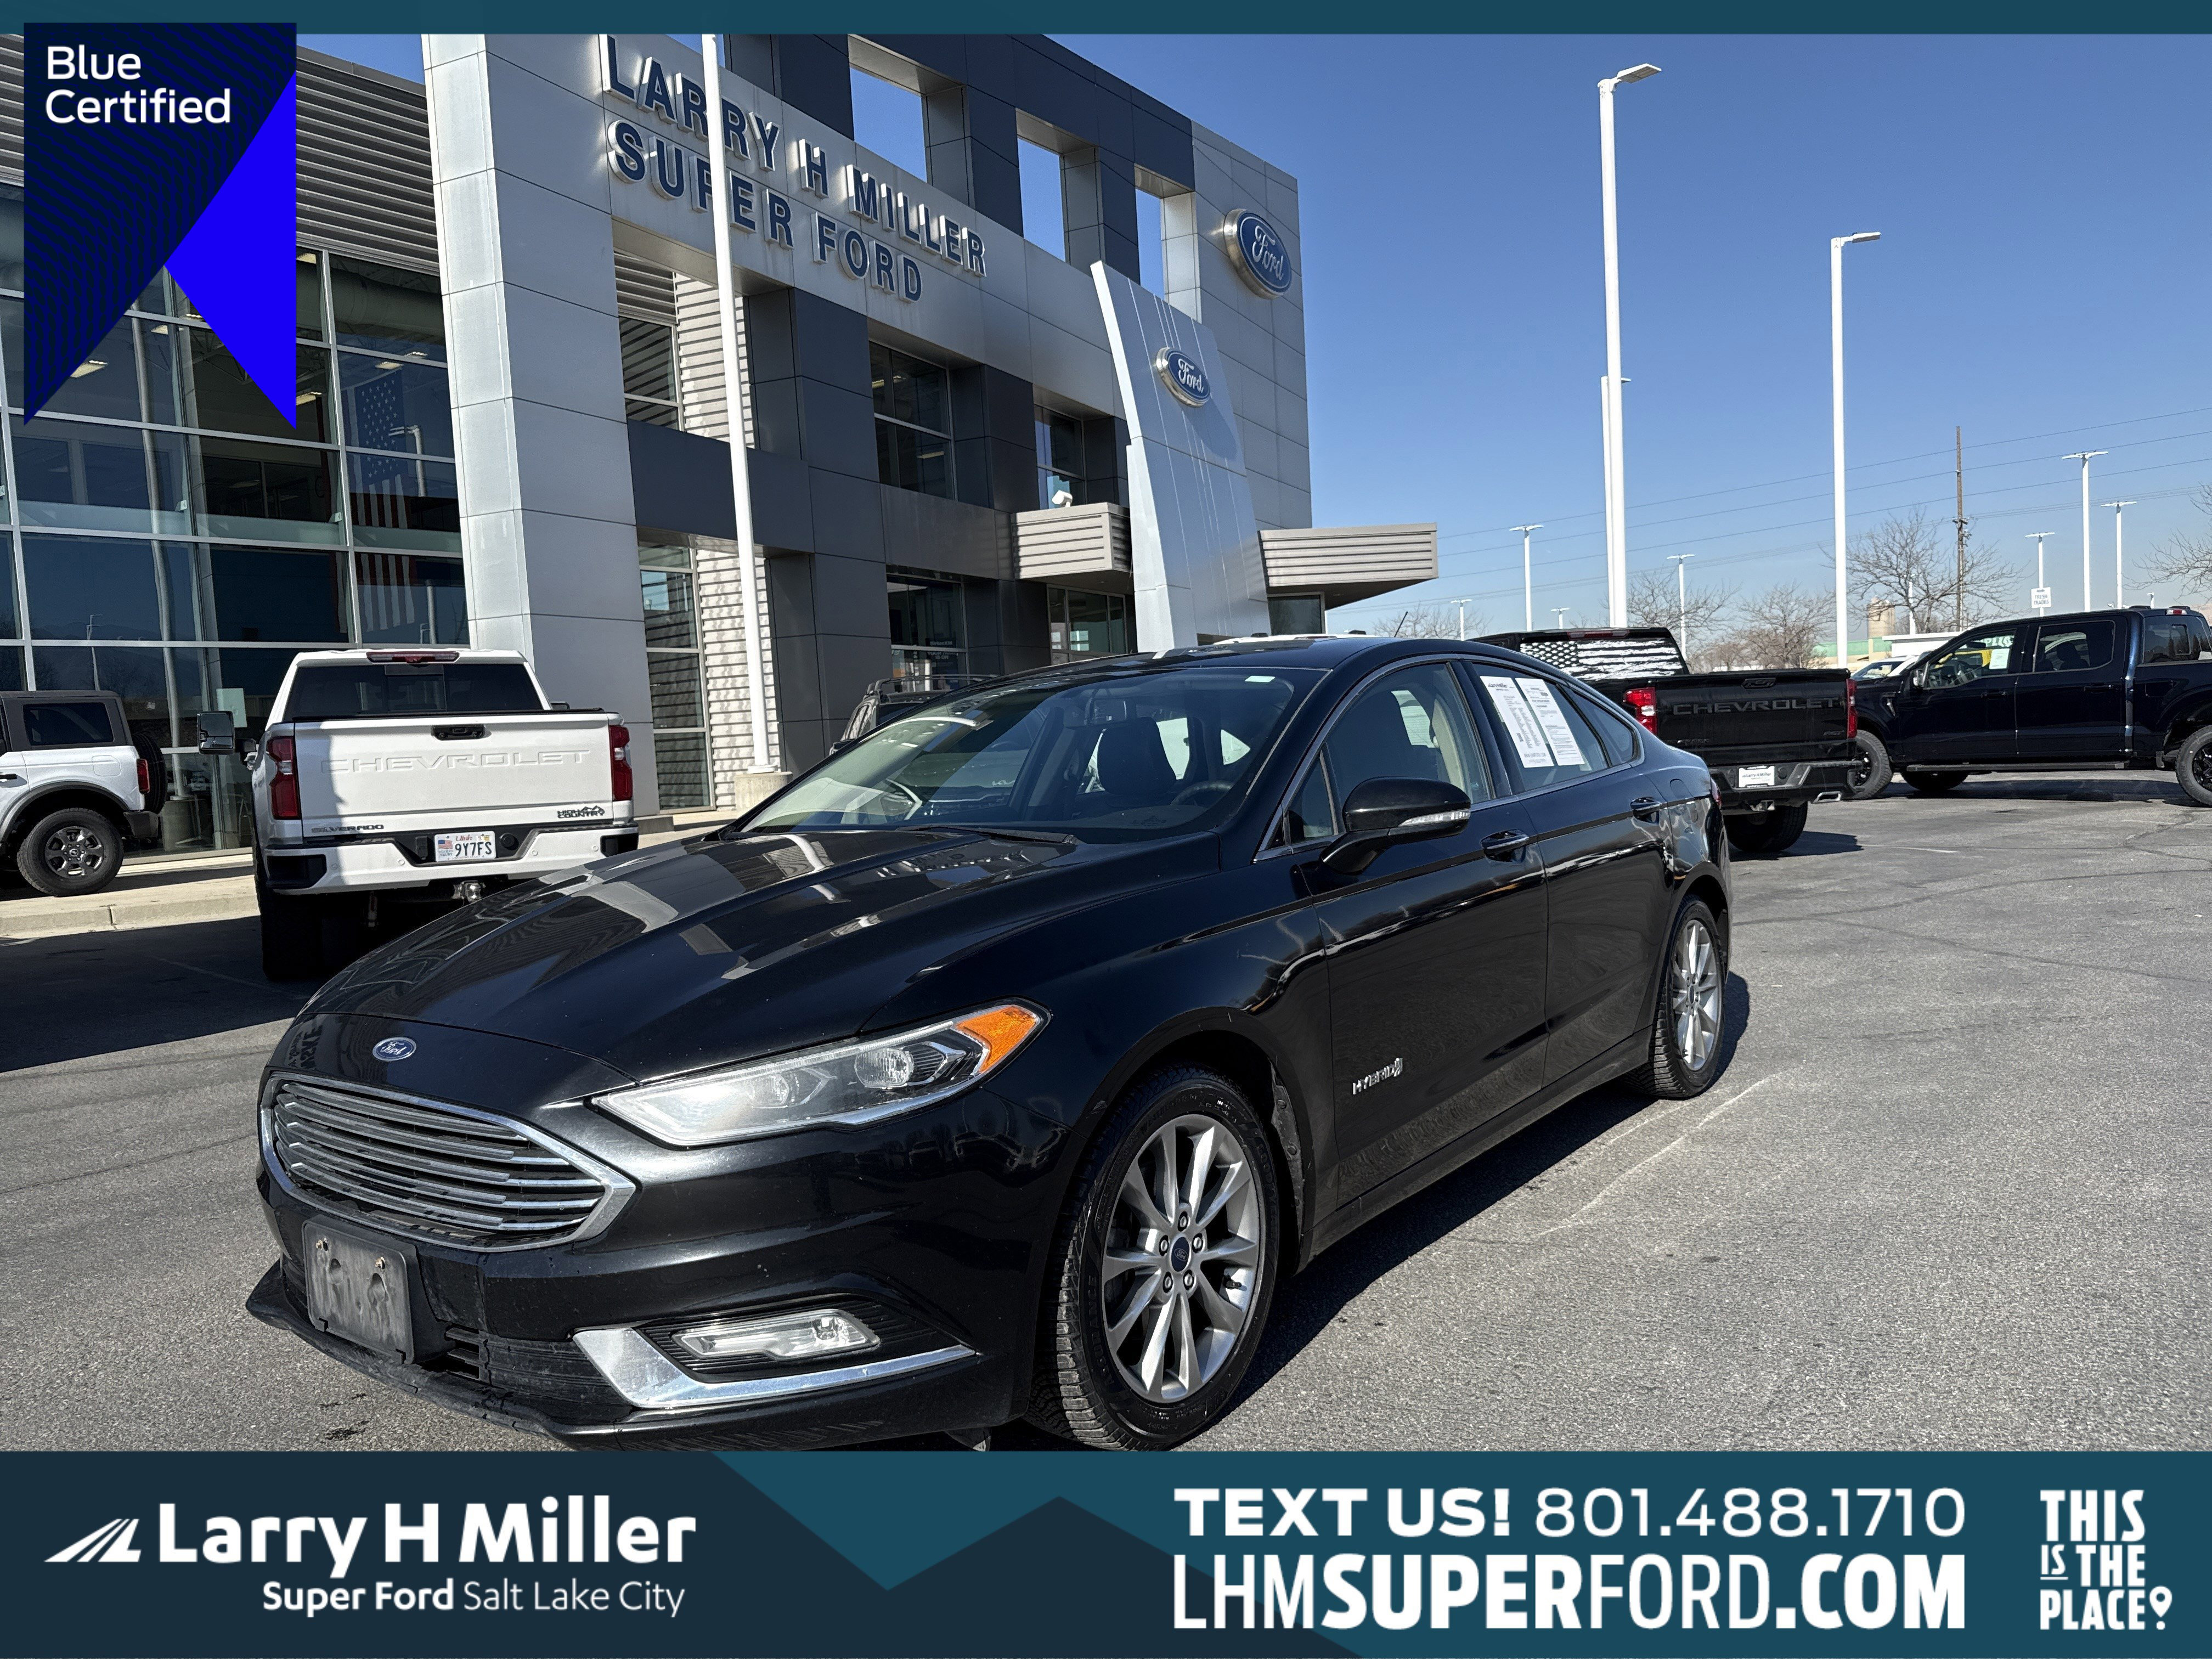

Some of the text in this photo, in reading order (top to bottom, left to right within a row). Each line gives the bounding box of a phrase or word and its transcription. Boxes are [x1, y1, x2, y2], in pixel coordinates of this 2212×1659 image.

[599, 34, 986, 277] LARRY H MILLER
[607, 120, 923, 302] SUPER FORD
[1251, 225, 1285, 281] Ford
[1178, 358, 1204, 393] Ford
[1673, 697, 1838, 715] CHEVROLET
[321, 749, 591, 774] CHEVROLET
[311, 824, 384, 833] SILVERADO
[455, 842, 492, 857] 9Y7FS
[1352, 1063, 1396, 1095] HYBRID
